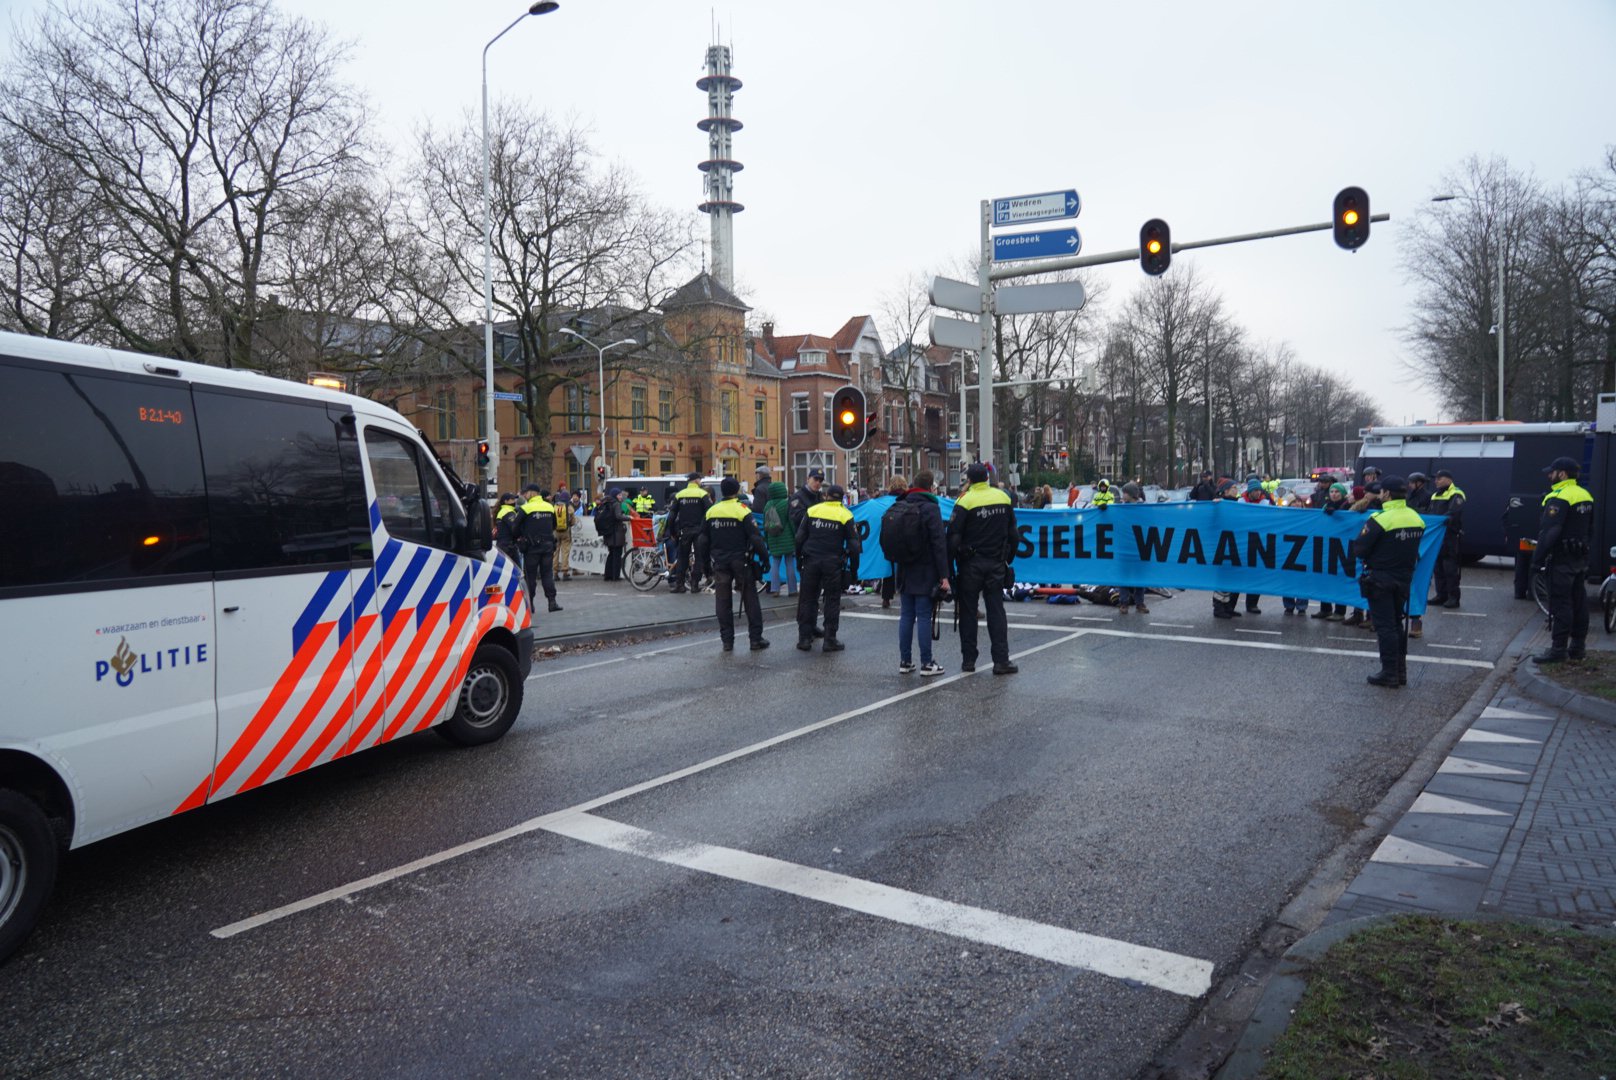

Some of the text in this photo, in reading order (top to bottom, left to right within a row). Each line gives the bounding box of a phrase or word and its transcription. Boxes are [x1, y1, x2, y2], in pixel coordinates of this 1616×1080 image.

[1011, 198, 1042, 208] Wedren
[1012, 207, 1065, 218] Vierdaagseplein
[996, 234, 1040, 246] Groesbeek
[976, 507, 1005, 519] POLITIE
[711, 519, 737, 528] POLITIE
[811, 518, 839, 530] POLITIE
[1014, 523, 1115, 560] SIELE
[1131, 525, 1357, 579] WAANZIN
[149, 619, 159, 629] en
[95, 643, 208, 687] POLITIE
